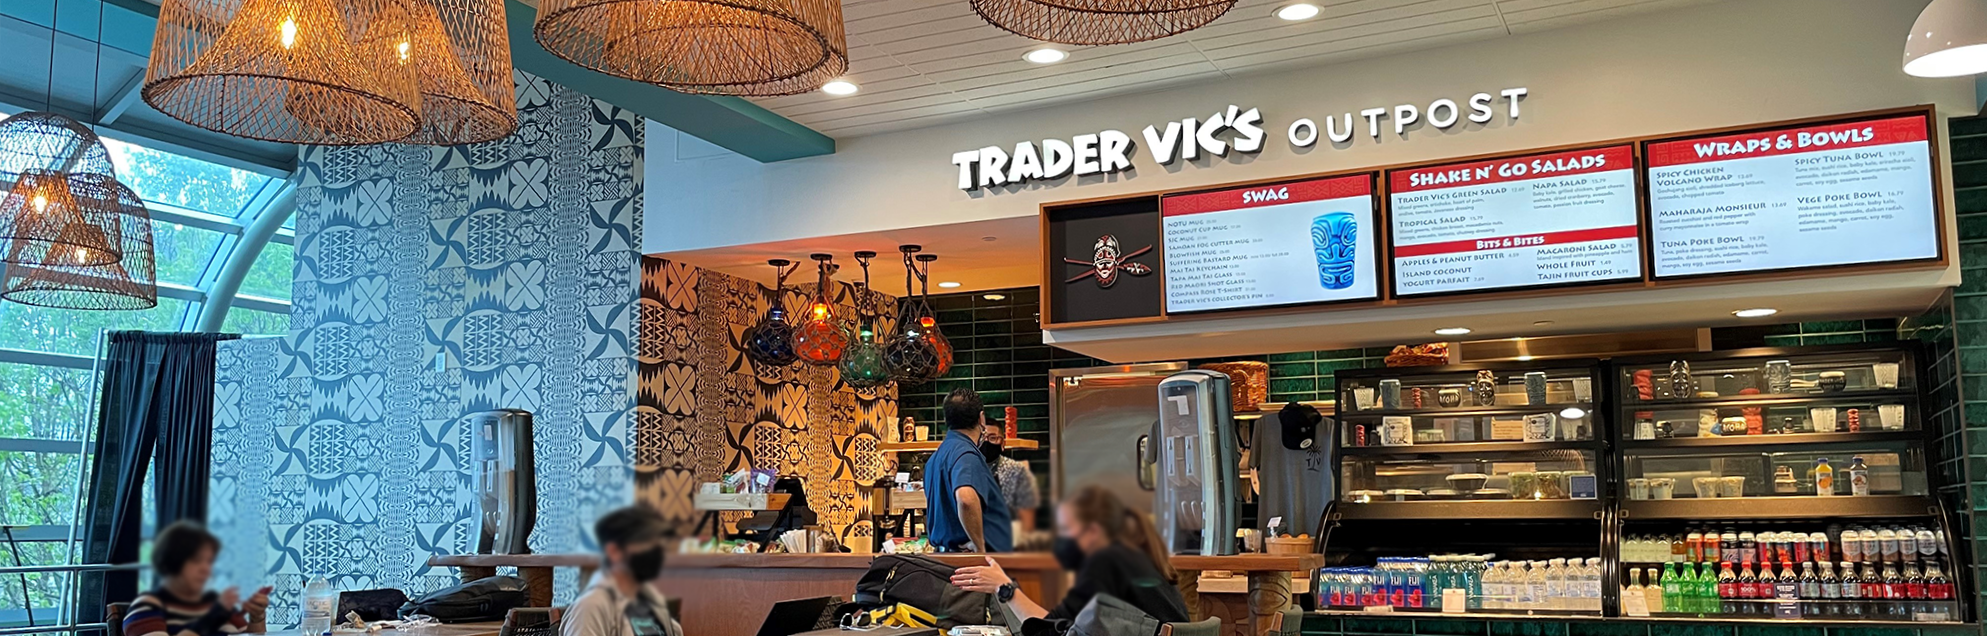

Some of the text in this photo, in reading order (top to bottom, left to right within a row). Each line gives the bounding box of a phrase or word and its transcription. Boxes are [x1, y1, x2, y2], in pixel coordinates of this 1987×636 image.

[952, 86, 1528, 190] TRADER VIC'S OUTPOST
[1694, 127, 1874, 158] WRAPS & BOWLS
[1795, 157, 1821, 165] SPICY
[1823, 155, 1852, 163] TUNA
[1855, 151, 1883, 160] BOWL
[1410, 154, 1605, 187] SHAKE N' GO SALADS
[1656, 167, 1724, 179] SPICY CHICKEN
[1533, 182, 1557, 190] NAPA
[1559, 179, 1587, 187] SALAD
[1656, 177, 1702, 186] VOLCANO
[1704, 174, 1733, 182] WRAP
[1243, 187, 1289, 204] SWAG
[1398, 196, 1429, 204] TRADER
[1452, 191, 1478, 199] GREEN
[1480, 187, 1507, 196] SALAD
[1797, 196, 1821, 204] VEGE
[1825, 194, 1850, 202] POKE
[1854, 191, 1882, 199] BOWL
[1659, 208, 1713, 217] MAHARAJA
[1715, 203, 1766, 213] MONSIEUR
[1399, 219, 1438, 227] TROPICAL
[1440, 216, 1466, 224] SALAD
[1167, 228, 1197, 236] COCONUT
[1477, 236, 1545, 249] BITS & BITES
[1690, 238, 1714, 246] POKE
[1717, 236, 1744, 244] BOWL
[1169, 251, 1200, 259] BLOWFISH
[1537, 246, 1586, 255] MACARONI
[1588, 243, 1617, 251] SALAD
[1402, 259, 1430, 267] APPLES
[1440, 255, 1472, 263] PEANUT
[1474, 253, 1504, 261] BUTTER
[1537, 262, 1568, 270] WHOLE
[1196, 264, 1228, 272] KEYCHAIN
[1403, 267, 1472, 278] ISLAND COCONUT
[1403, 279, 1435, 287] YOGURT
[1409, 576, 1420, 585] FIJI
